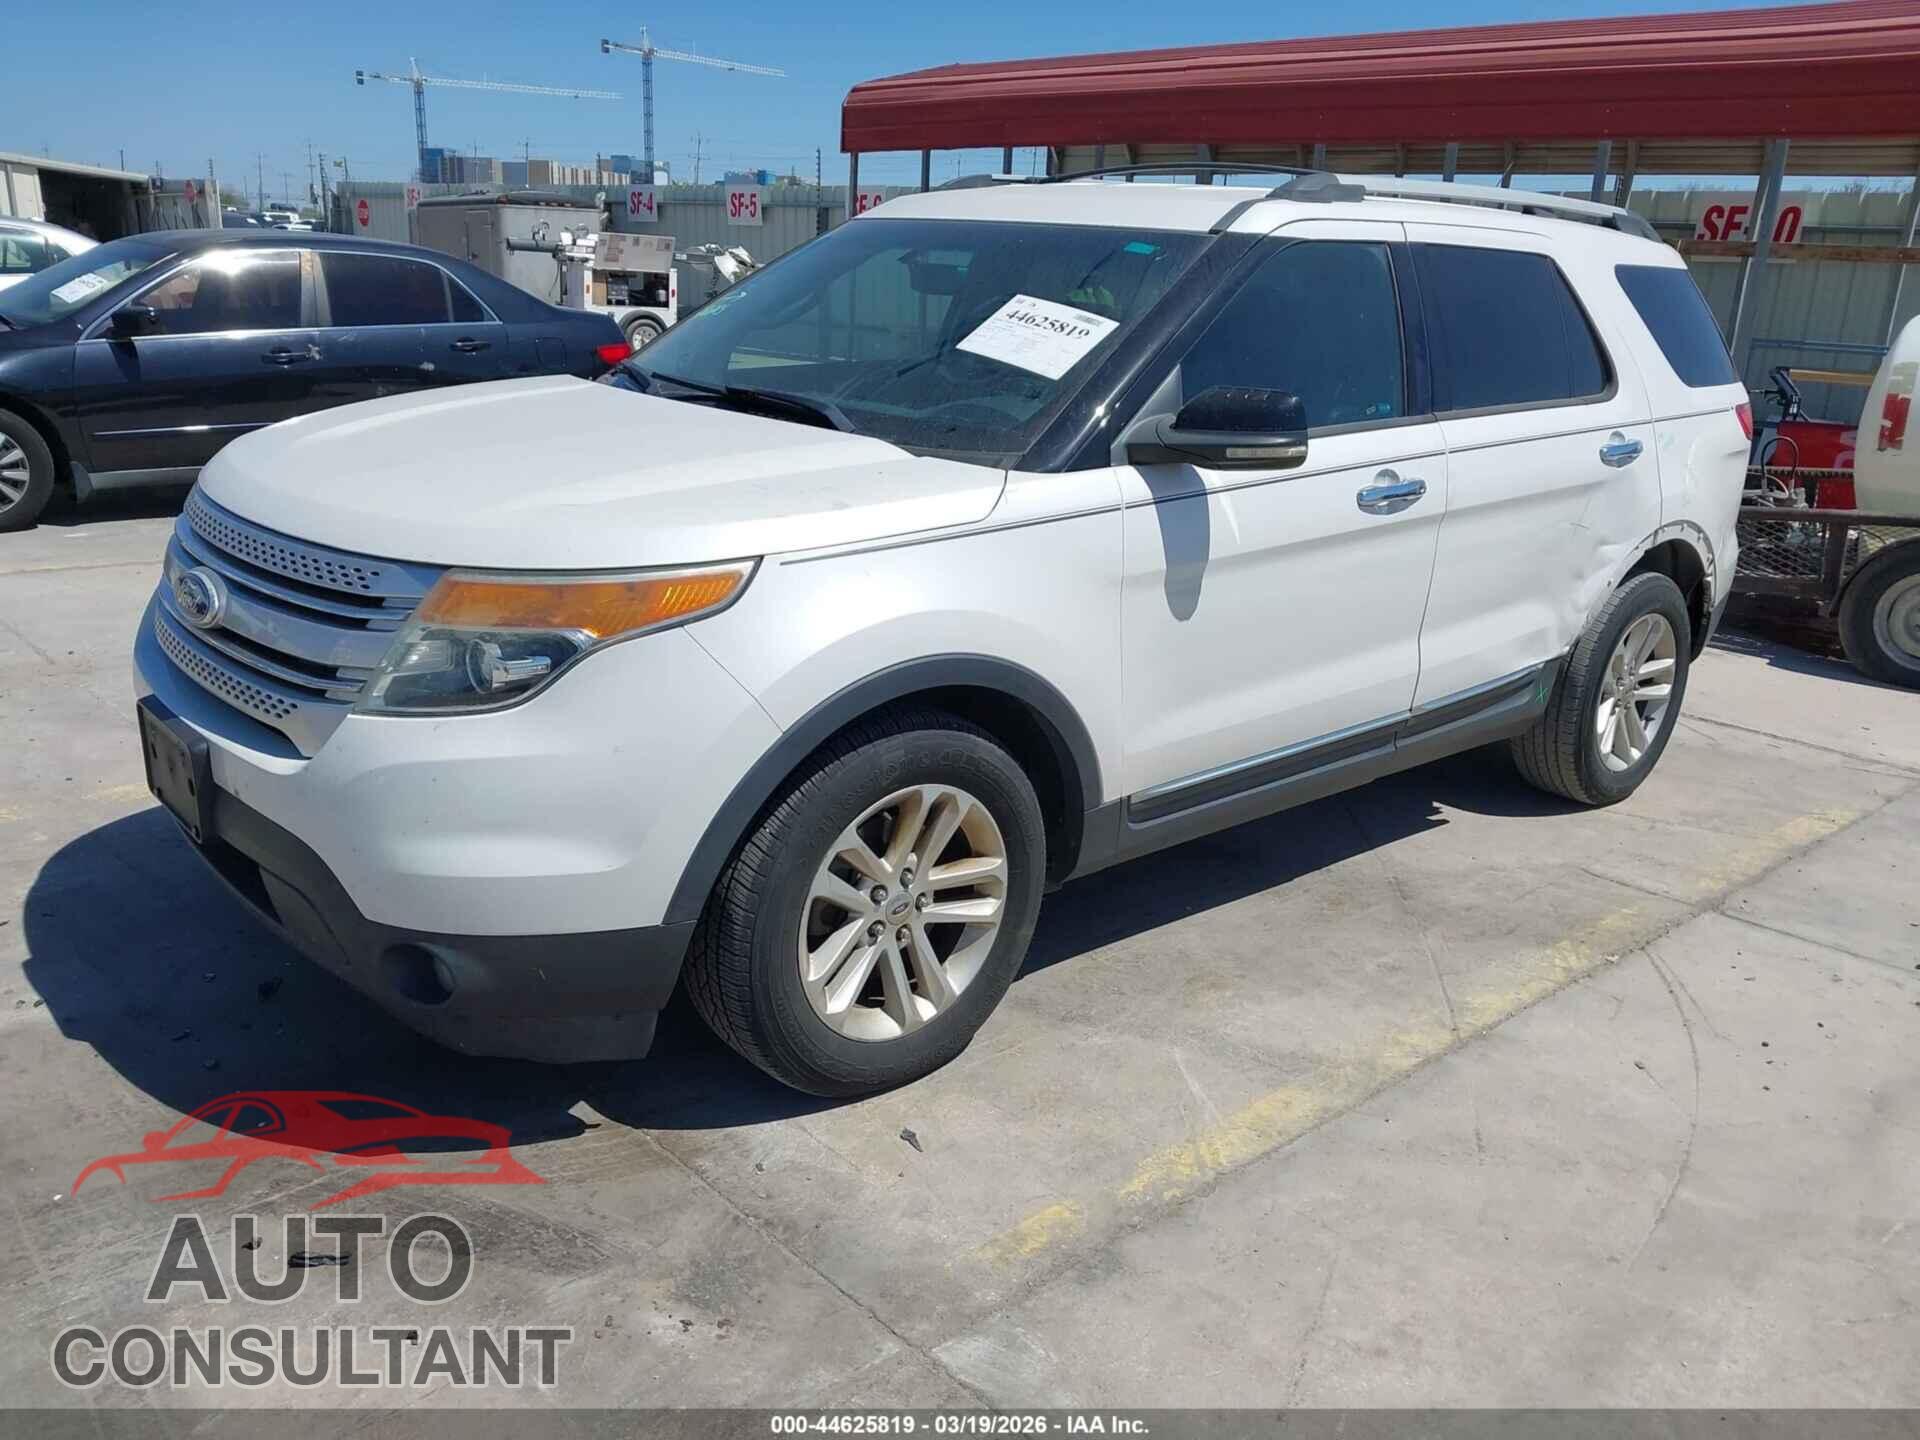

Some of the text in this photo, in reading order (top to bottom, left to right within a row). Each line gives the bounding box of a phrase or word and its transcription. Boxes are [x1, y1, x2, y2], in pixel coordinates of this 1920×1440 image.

[630, 191, 653, 215] SF-4
[730, 192, 757, 218] SF-5
[1006, 310, 1090, 339] 44625819
